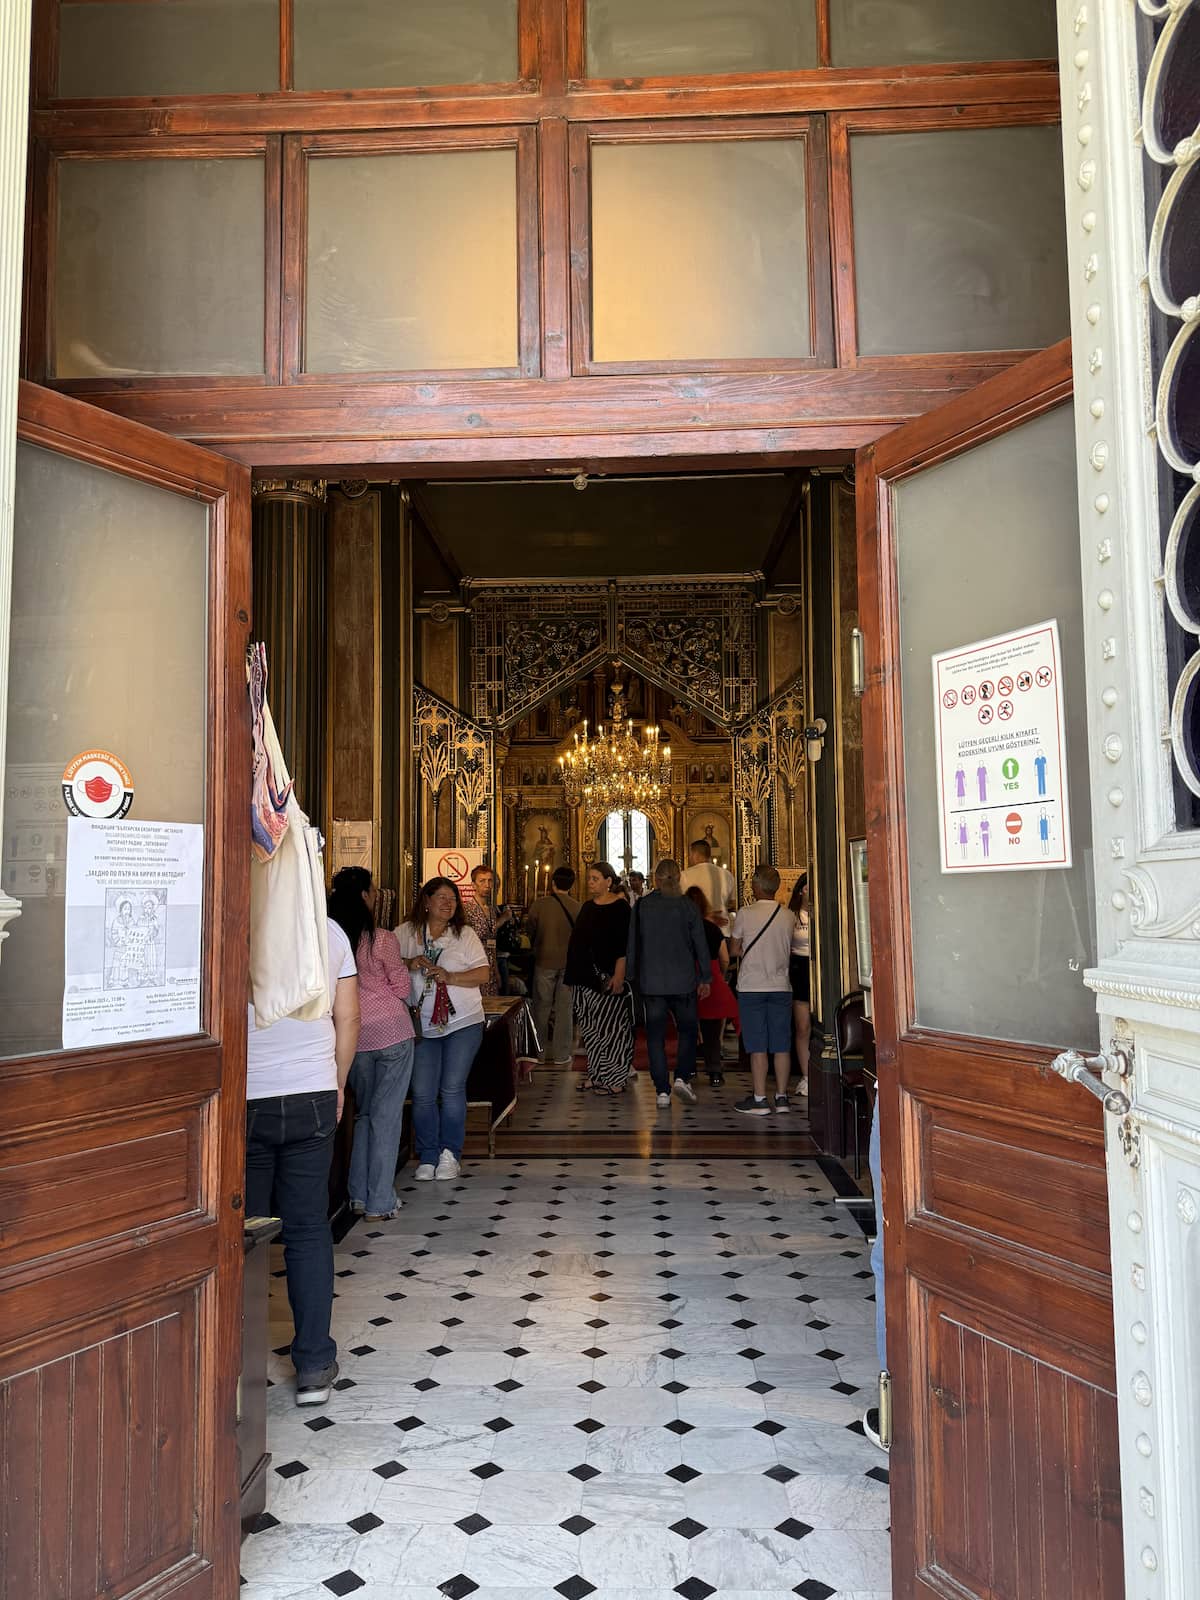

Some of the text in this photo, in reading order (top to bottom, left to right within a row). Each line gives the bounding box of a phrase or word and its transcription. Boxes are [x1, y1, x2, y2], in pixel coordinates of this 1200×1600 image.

[958, 727, 1038, 749] LÜTFEN GEÇERLİ KILIK KIYAFET
[958, 746, 987, 758] KODEKSİNE
[988, 743, 1005, 752] UYUM
[1003, 782, 1019, 790] YES
[64, 787, 73, 809] PLEASE
[123, 795, 131, 811] MASK
[1008, 837, 1020, 845] NO
